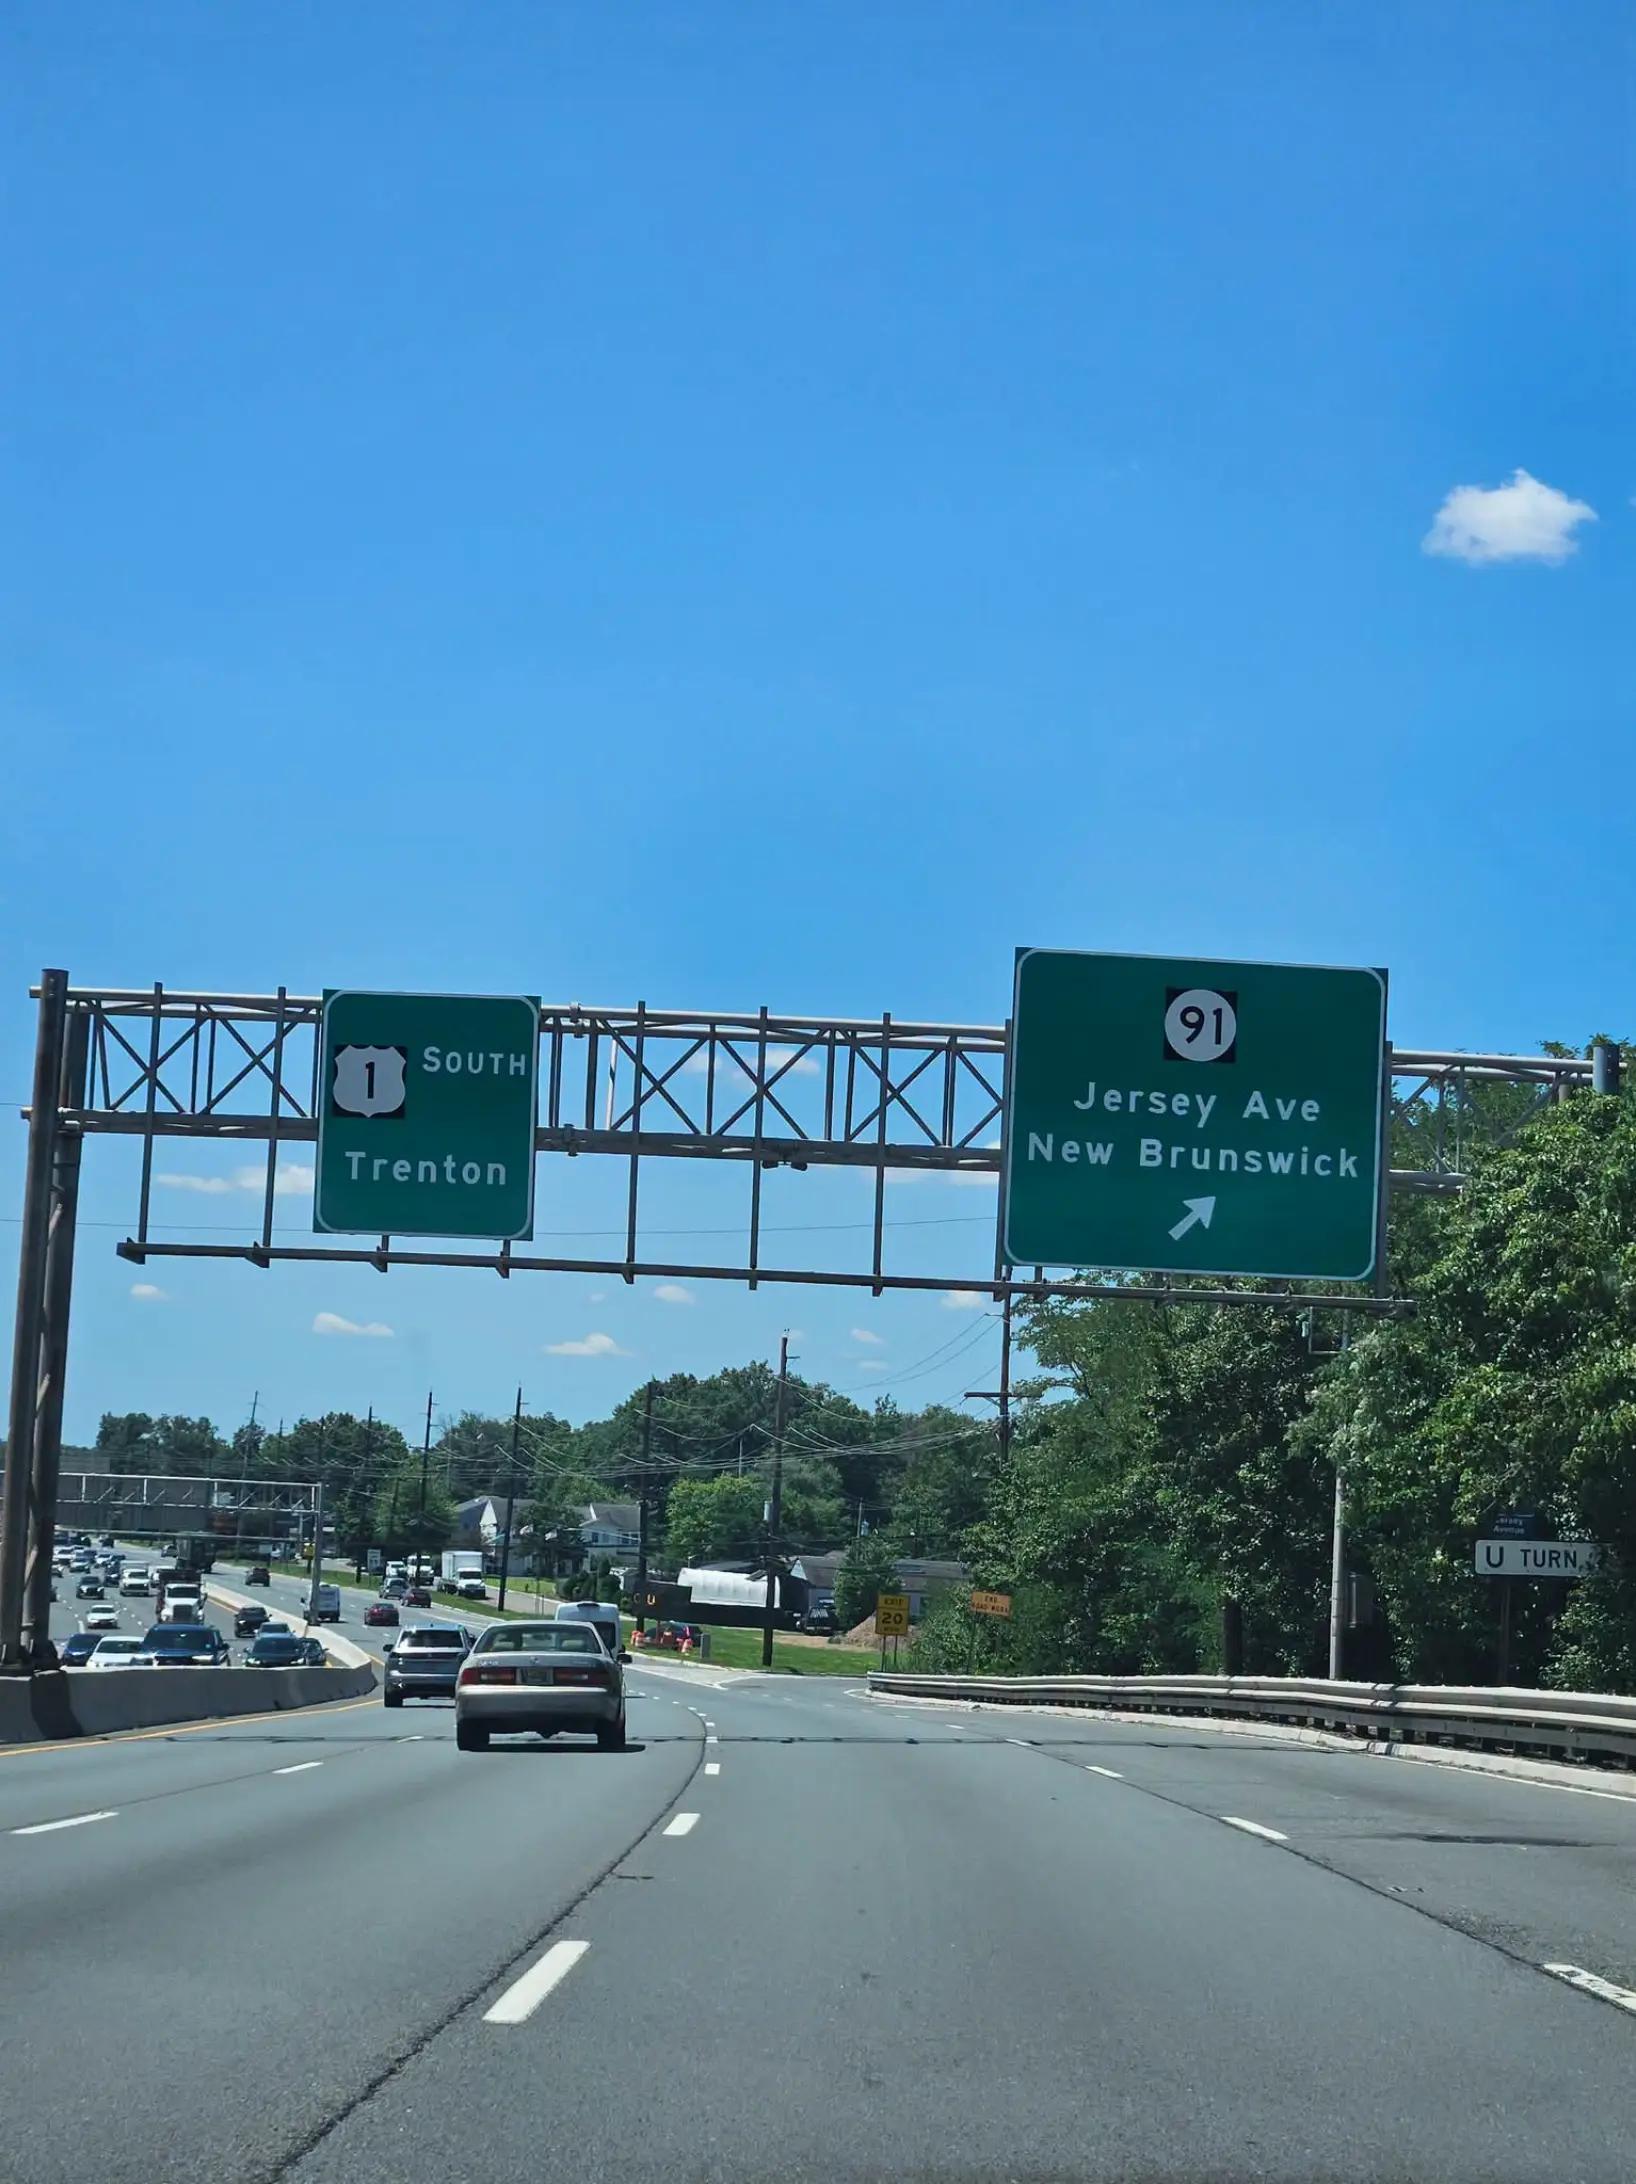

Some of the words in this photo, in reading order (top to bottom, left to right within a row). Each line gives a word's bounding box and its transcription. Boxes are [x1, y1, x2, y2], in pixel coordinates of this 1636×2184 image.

[1179, 1005, 1222, 1046] 91
[422, 1046, 526, 1076] SOUTH
[365, 1061, 375, 1100] 1
[1073, 1081, 1217, 1128] Jersey
[1242, 1090, 1321, 1122] Ave
[345, 1151, 507, 1186] Trenton
[1027, 1132, 1114, 1165] New
[1139, 1137, 1359, 1178] Brunswick
[1485, 1546, 1505, 1568] U
[1520, 1549, 1577, 1569] TURN
[881, 1611, 904, 1625] 20
